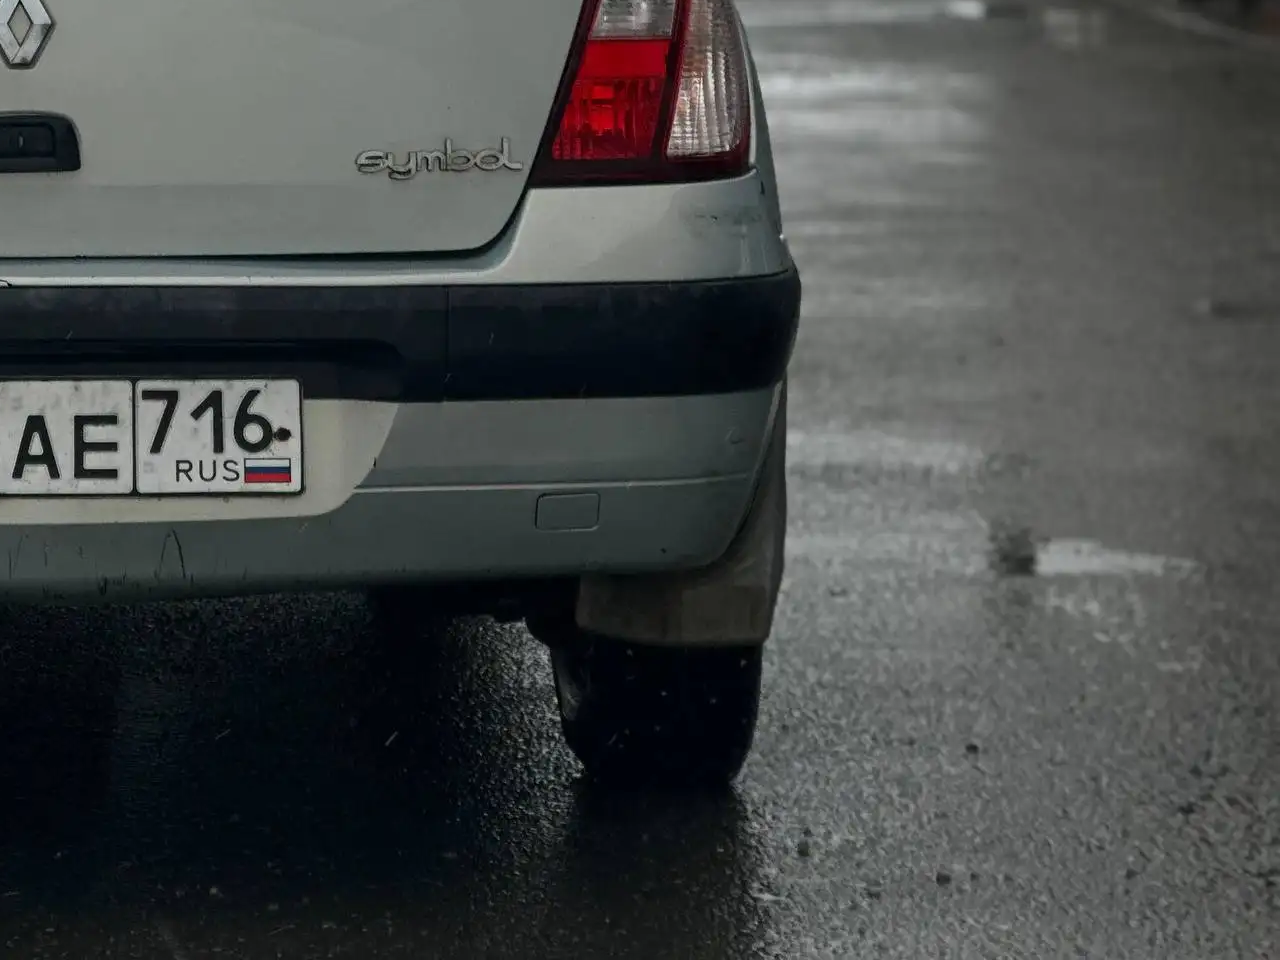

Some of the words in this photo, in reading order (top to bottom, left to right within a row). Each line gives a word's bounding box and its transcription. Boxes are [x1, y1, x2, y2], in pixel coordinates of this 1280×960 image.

[355, 137, 524, 180] symbol
[141, 389, 274, 455] 716
[175, 458, 240, 482] RUS
